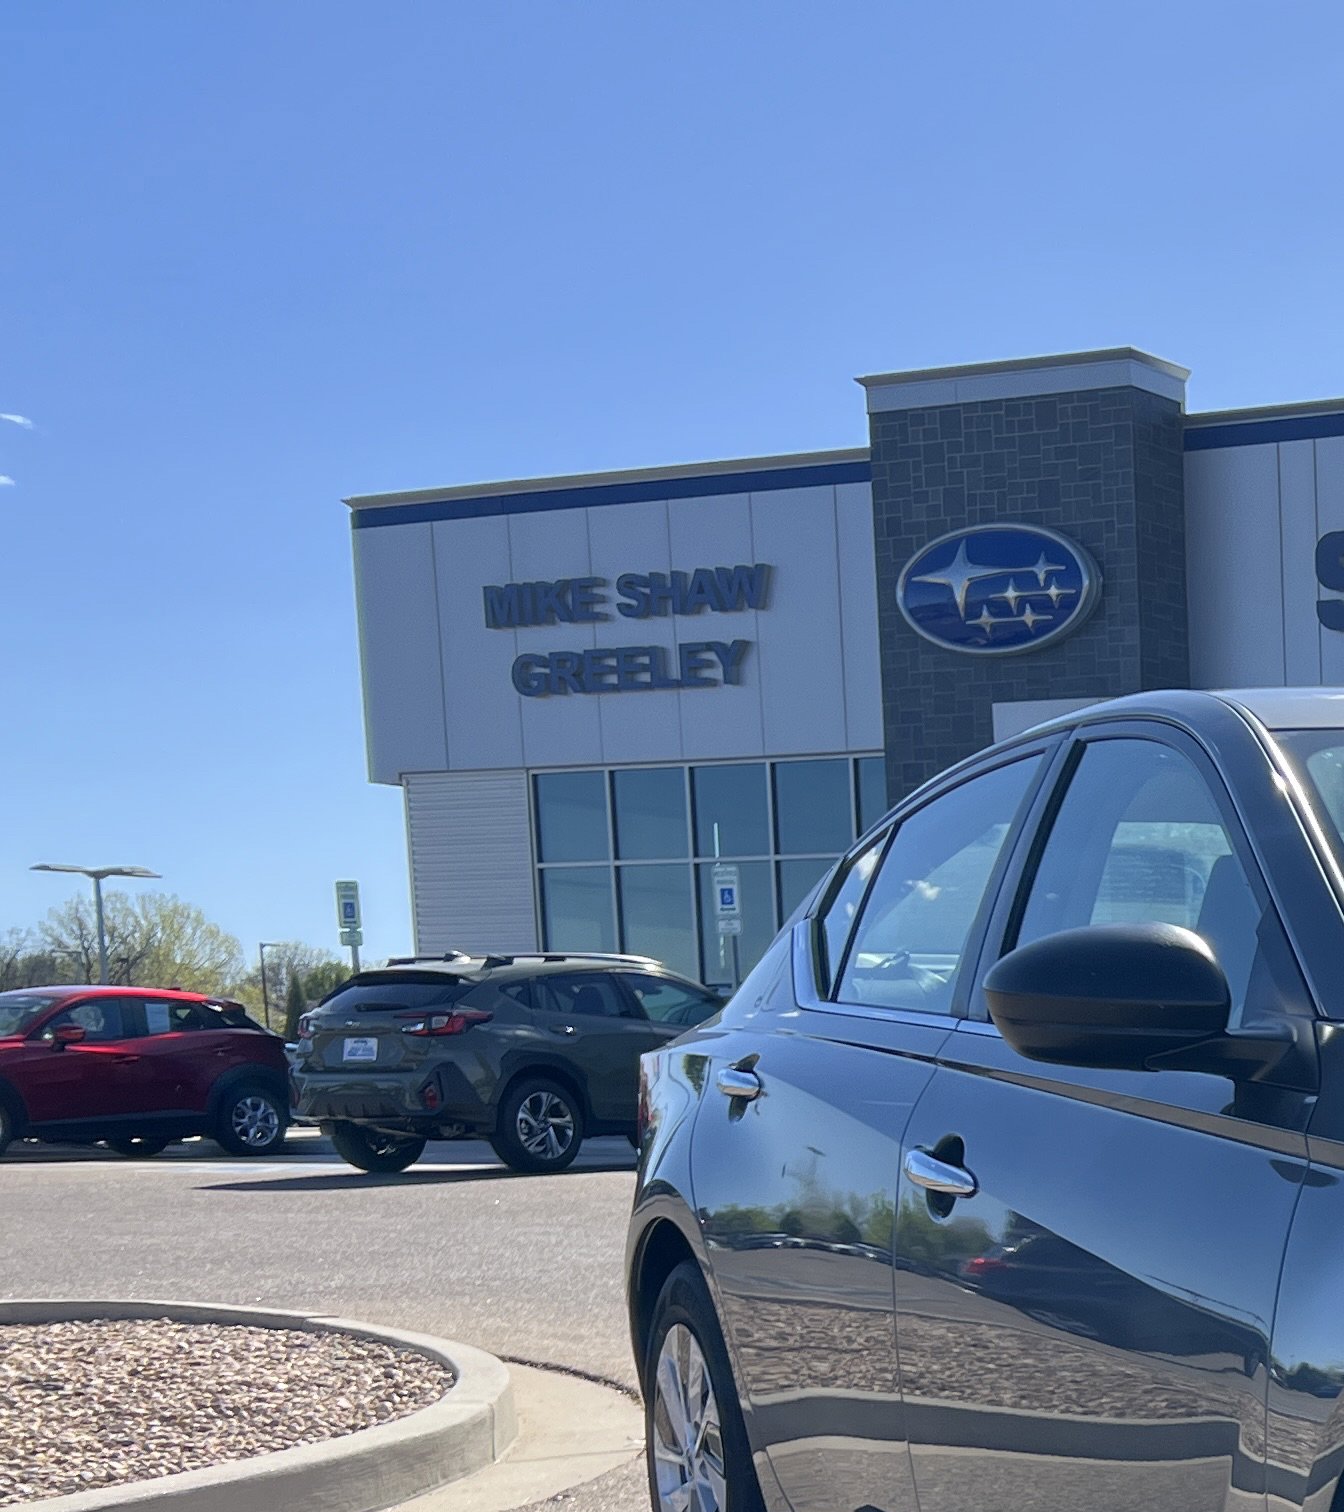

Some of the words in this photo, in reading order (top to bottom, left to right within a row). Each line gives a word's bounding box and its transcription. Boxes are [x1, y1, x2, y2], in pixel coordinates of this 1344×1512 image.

[483, 576, 606, 629] MIKE
[616, 563, 772, 618] SHAW
[512, 638, 752, 698] GREELEY
